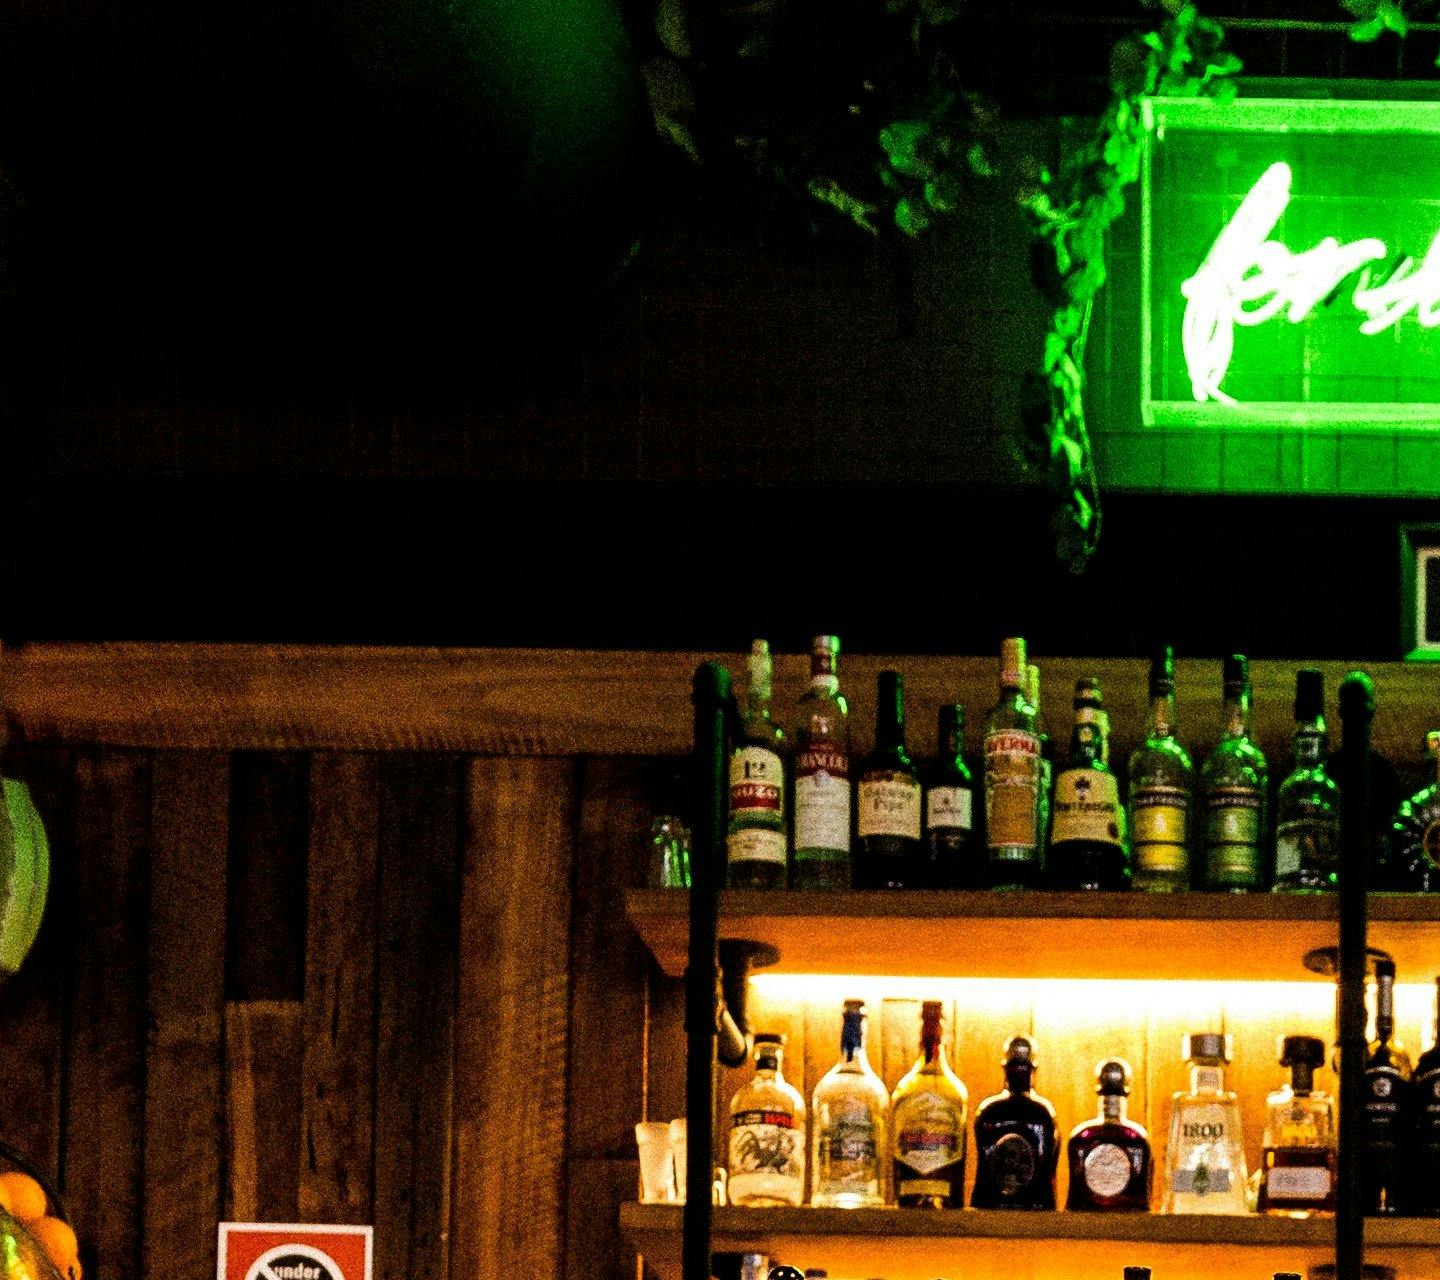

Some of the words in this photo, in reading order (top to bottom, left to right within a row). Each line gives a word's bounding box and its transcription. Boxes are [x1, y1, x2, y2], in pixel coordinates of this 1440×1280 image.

[1181, 162, 1386, 402] for
[733, 785, 778, 798] OUZO
[1184, 1124, 1224, 1138] 1800
